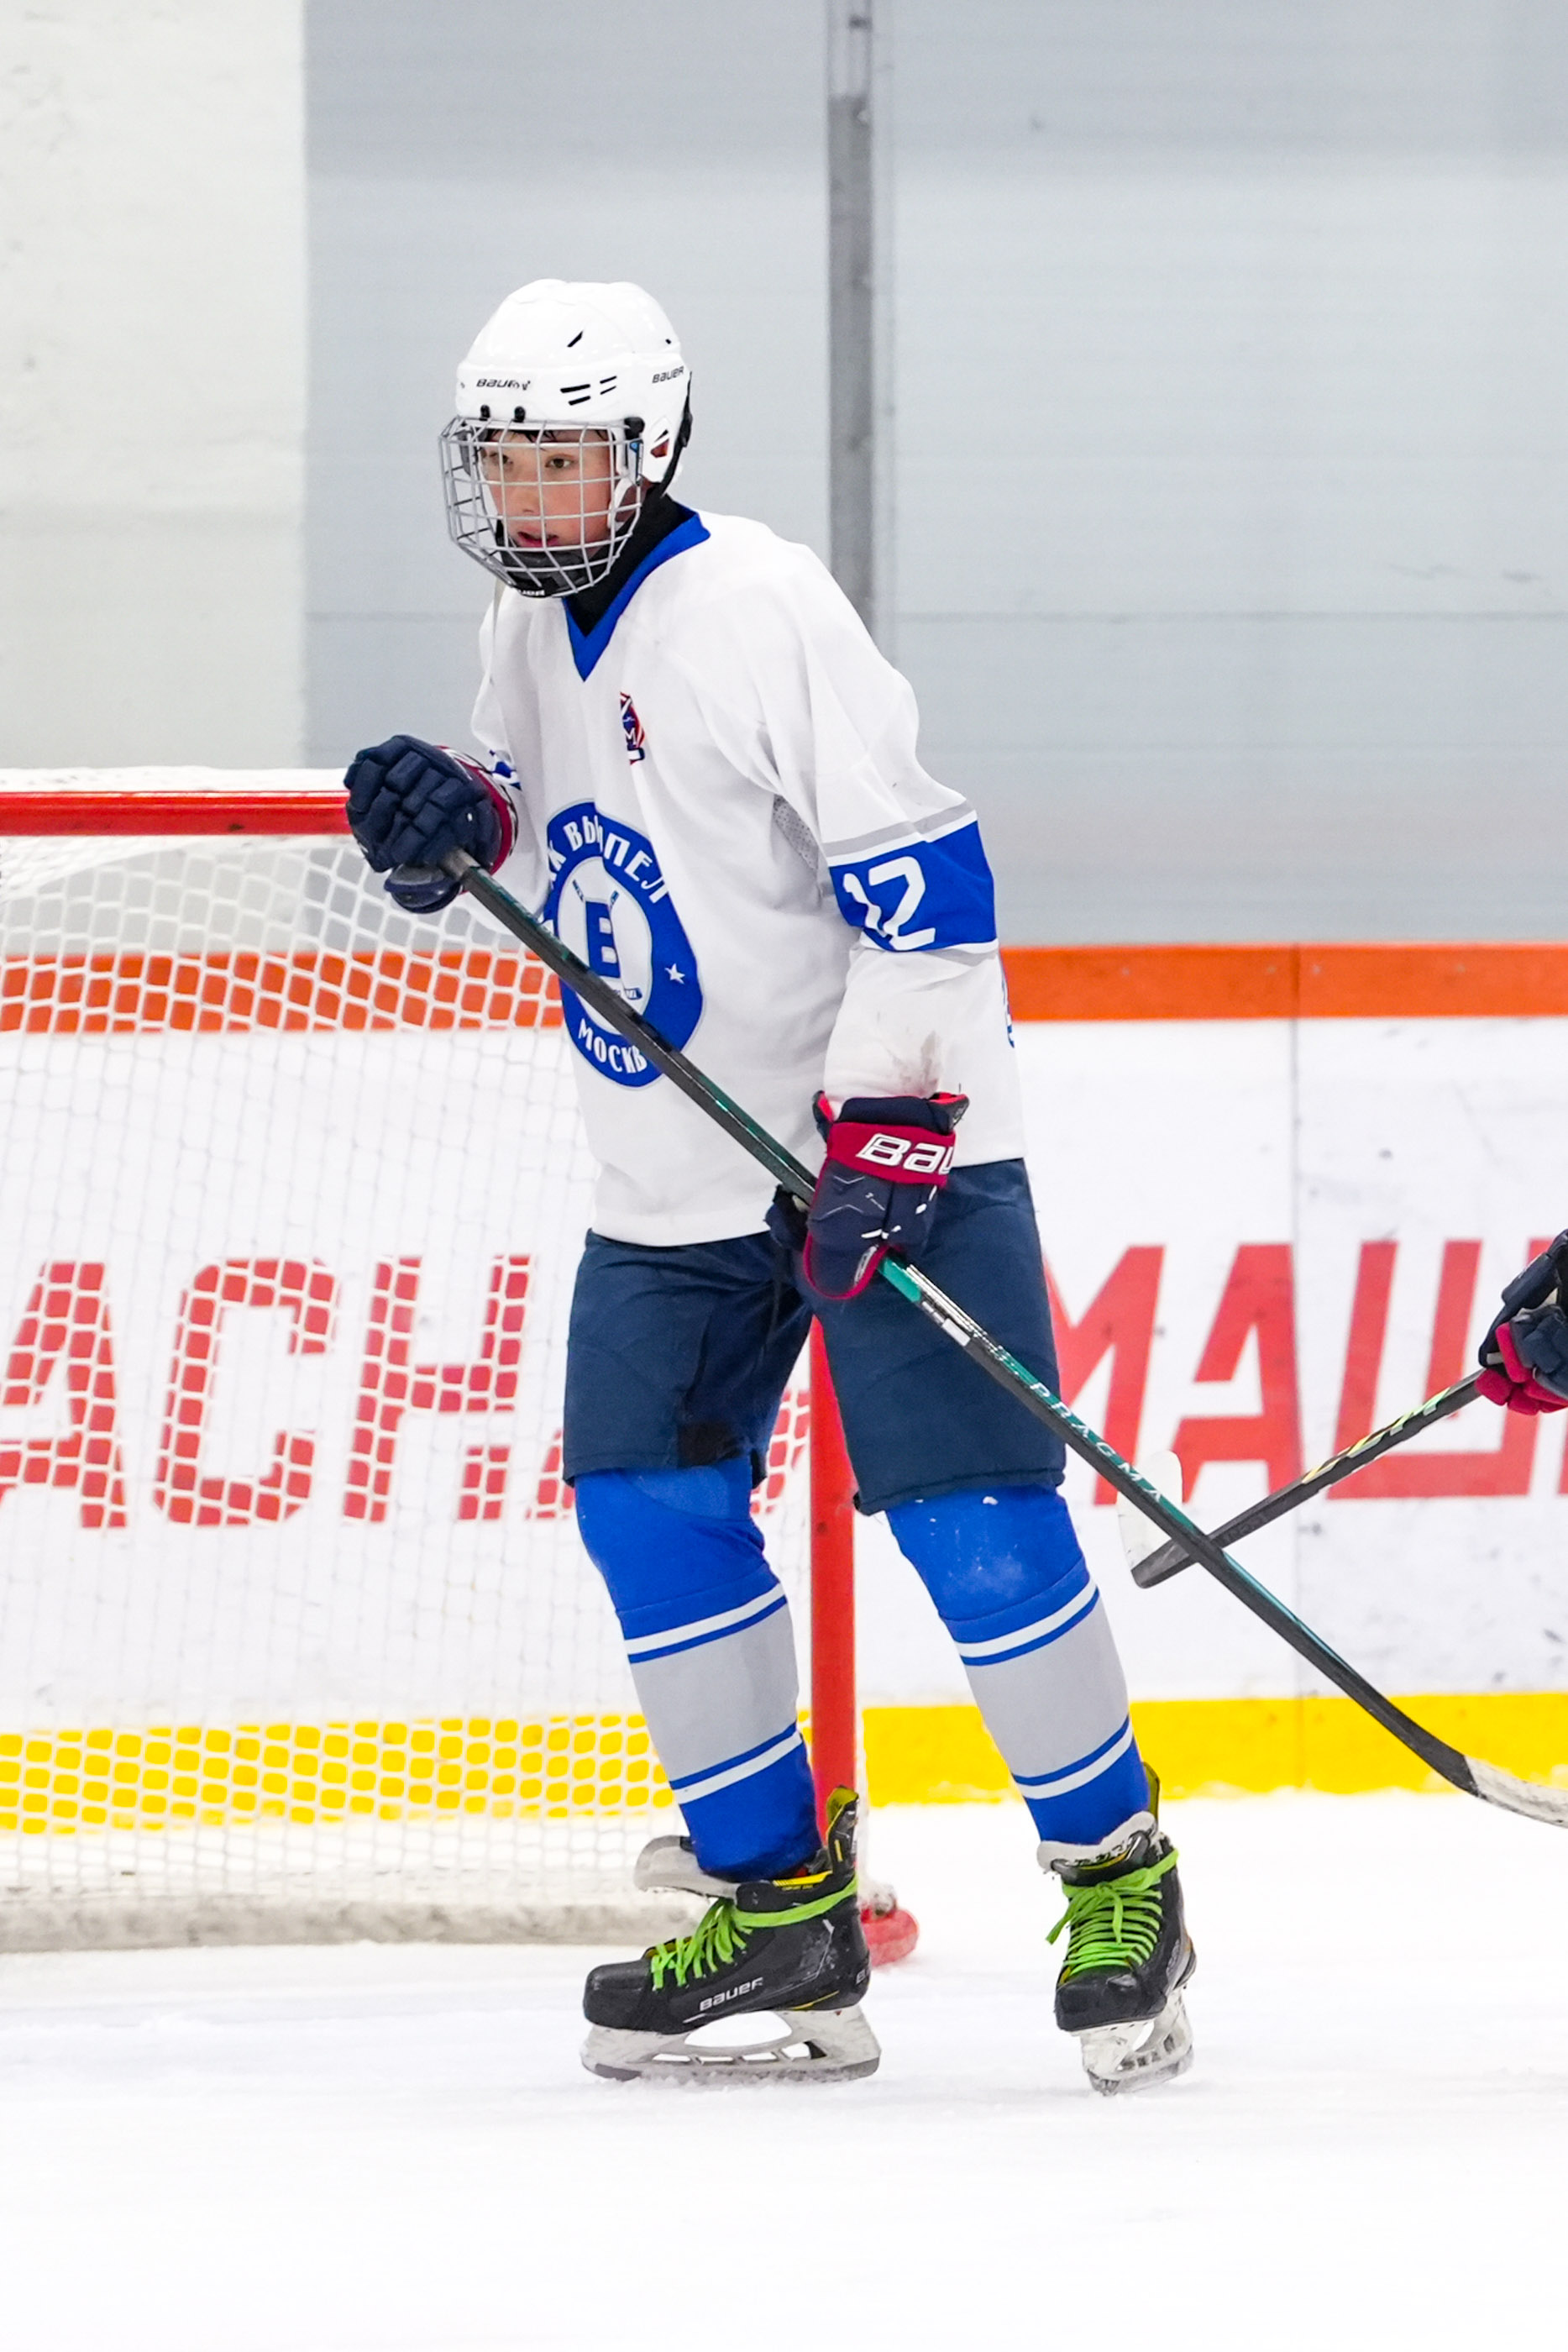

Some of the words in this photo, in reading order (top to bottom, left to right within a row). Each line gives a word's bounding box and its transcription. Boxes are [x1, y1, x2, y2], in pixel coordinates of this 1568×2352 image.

[843, 855, 936, 951] 12
[578, 1017, 648, 1074] МОСКВ
[1042, 1238, 1568, 1506] МАШ
